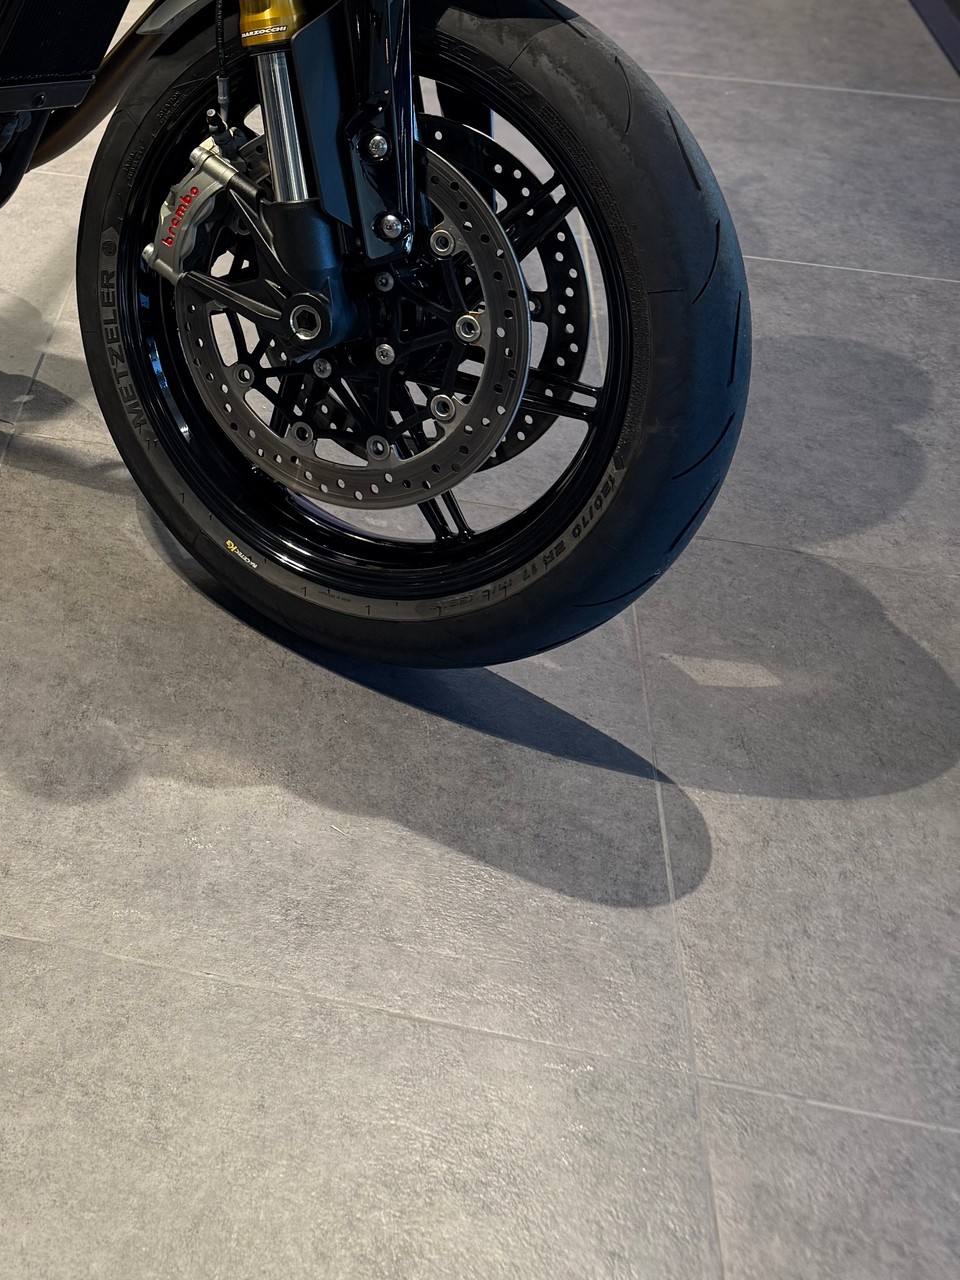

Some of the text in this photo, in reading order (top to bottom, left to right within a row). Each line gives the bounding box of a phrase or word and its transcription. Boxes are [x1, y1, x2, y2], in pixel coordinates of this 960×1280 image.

[241, 25, 288, 38] MARZOCCHI
[161, 186, 199, 249] brembo
[100, 269, 148, 430] METZELER
[571, 473, 617, 540] 120/70
[234, 547, 258, 569] RACETEC
